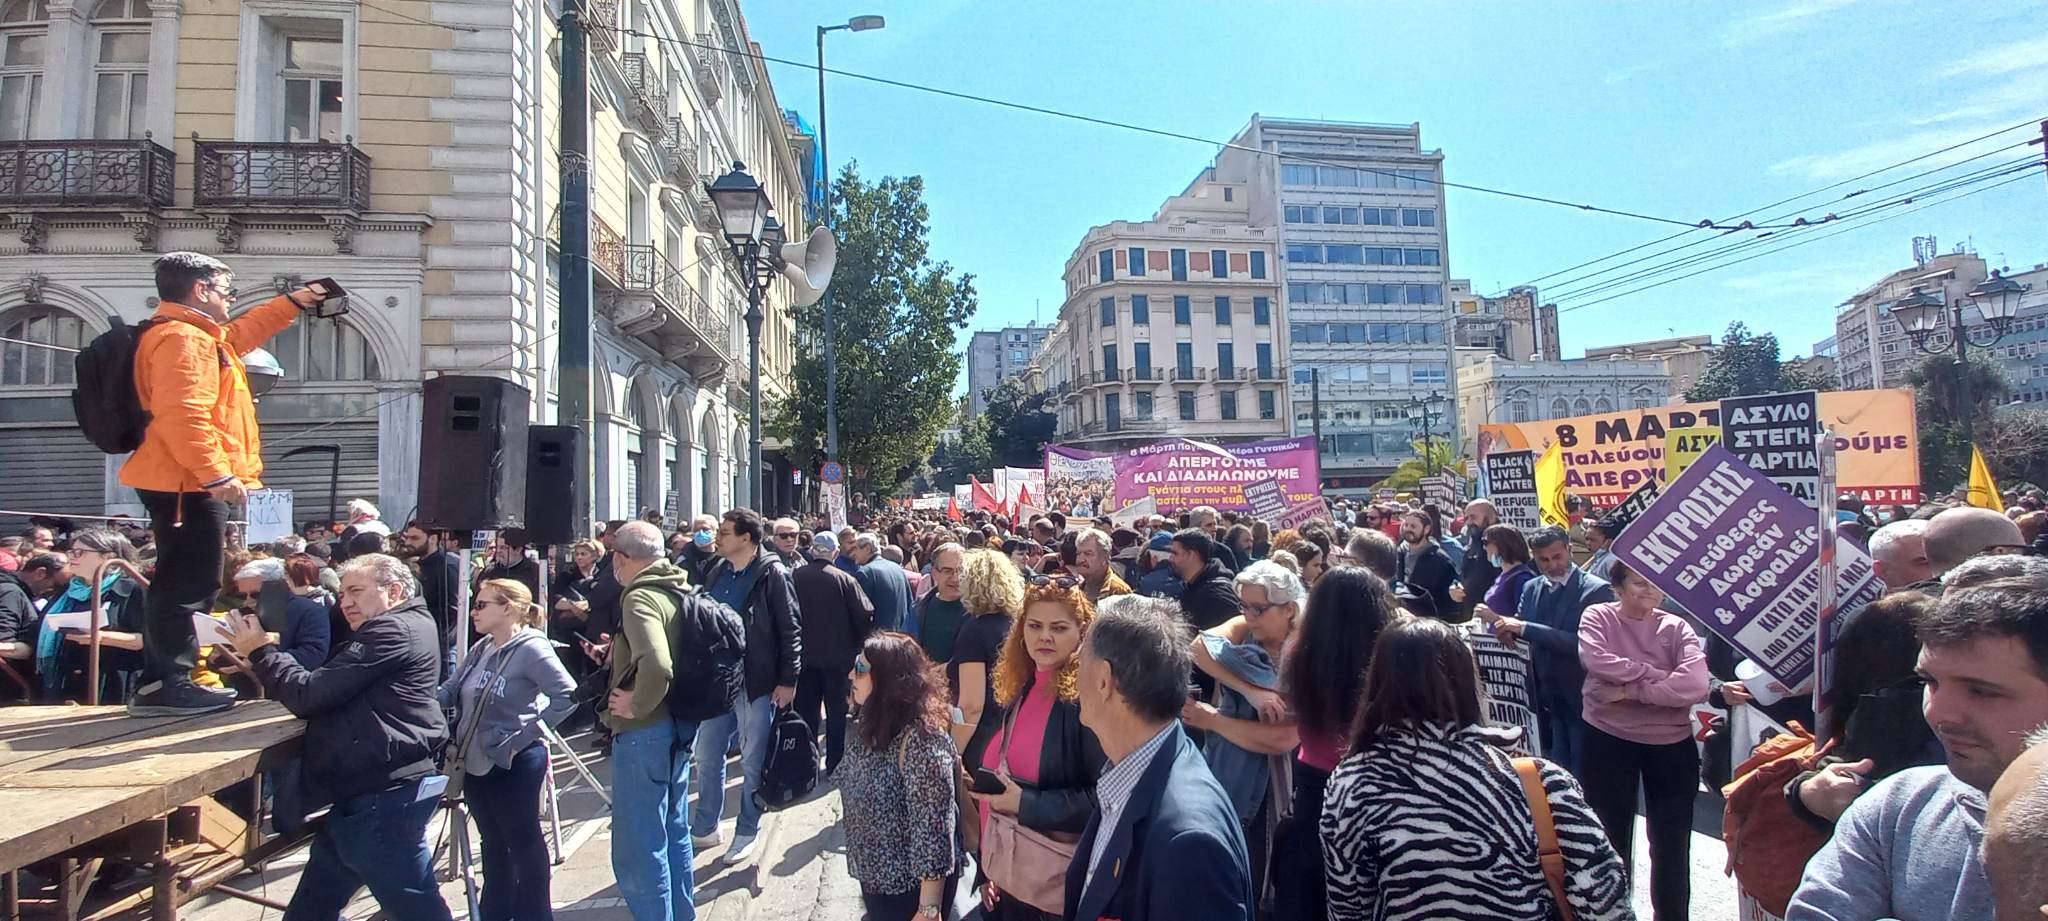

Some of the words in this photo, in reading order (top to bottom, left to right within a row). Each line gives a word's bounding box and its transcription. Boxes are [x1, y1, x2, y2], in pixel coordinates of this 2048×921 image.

[1730, 403, 1810, 425] ΑΣΥΛΟ
[1556, 424, 1578, 448] 8
[1734, 427, 1810, 448] ΣΤΕΓΗ
[1834, 431, 1908, 453] ούμε
[1140, 445, 1175, 456] Μάρτη
[1255, 441, 1300, 453] Γυναικών
[1168, 456, 1267, 469] ΑΠΕΡΓΟΥΜΕ
[1489, 456, 1524, 468] BLACK
[1134, 471, 1163, 484] ΚΑΙ
[1166, 467, 1300, 482] ΔΙΑΔΗΛΩΝΟΥΜΕ
[1490, 468, 1522, 480] LIVES
[1148, 485, 1191, 496] Ενάντια
[1193, 486, 1228, 496] στους
[1491, 479, 1533, 491] MATTER
[1204, 497, 1221, 505] την
[1287, 493, 1314, 503] τους
[1494, 496, 1537, 508] REFUGEE
[1590, 494, 1619, 505] ΗΣΗ
[1293, 505, 1324, 524] ΜΑΡΤΗ
[1497, 507, 1526, 517] LIVES
[1631, 460, 1754, 574] ΕΚΤΡΩΣΕΙΣ
[1675, 499, 1778, 591] Ελεύθερες
[1709, 523, 1785, 597] Δωρεάν
[1714, 607, 1736, 625] &
[1731, 526, 1819, 612] Ασφαλείς
[1757, 600, 1796, 633] ΚΑΤΩ
[1785, 587, 1810, 606] ΤΑ
[1763, 638, 1789, 660] ΑΠΟ
[1781, 624, 1804, 643] ΤΙΣ
[1839, 557, 1872, 586] ΜΑΣ
